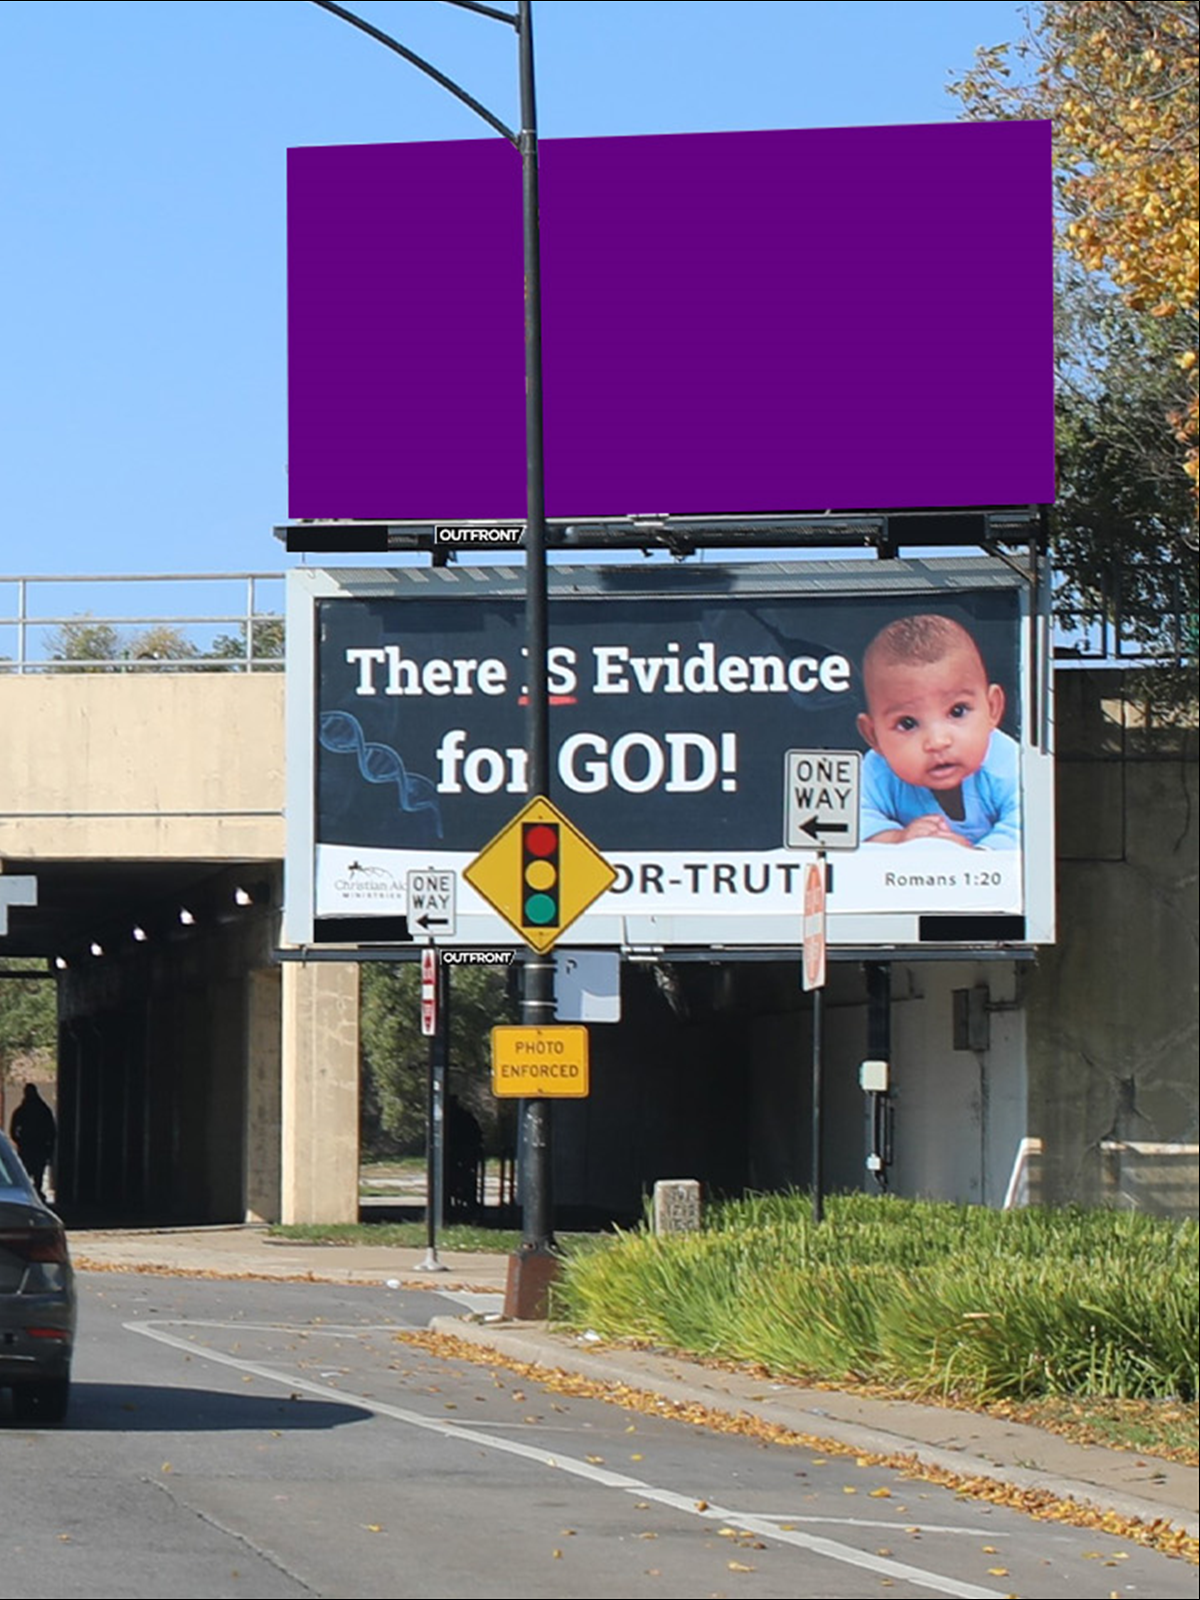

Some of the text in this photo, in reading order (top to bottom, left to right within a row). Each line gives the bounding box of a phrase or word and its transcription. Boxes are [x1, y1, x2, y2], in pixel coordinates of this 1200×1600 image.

[439, 528, 520, 541] OUTFRONT
[346, 645, 507, 696] There
[592, 642, 851, 694] Evidence
[557, 731, 737, 794] GOD!
[796, 760, 851, 783] ONE
[795, 786, 851, 810] WAY
[334, 879, 388, 892] Christian
[412, 876, 450, 892] ONE
[885, 872, 1002, 886] Romans 1:20
[412, 894, 450, 910] WAY
[443, 951, 512, 965] OUTFRONT
[515, 1040, 564, 1055] PHOTO
[501, 1064, 579, 1078] ENFORCED
